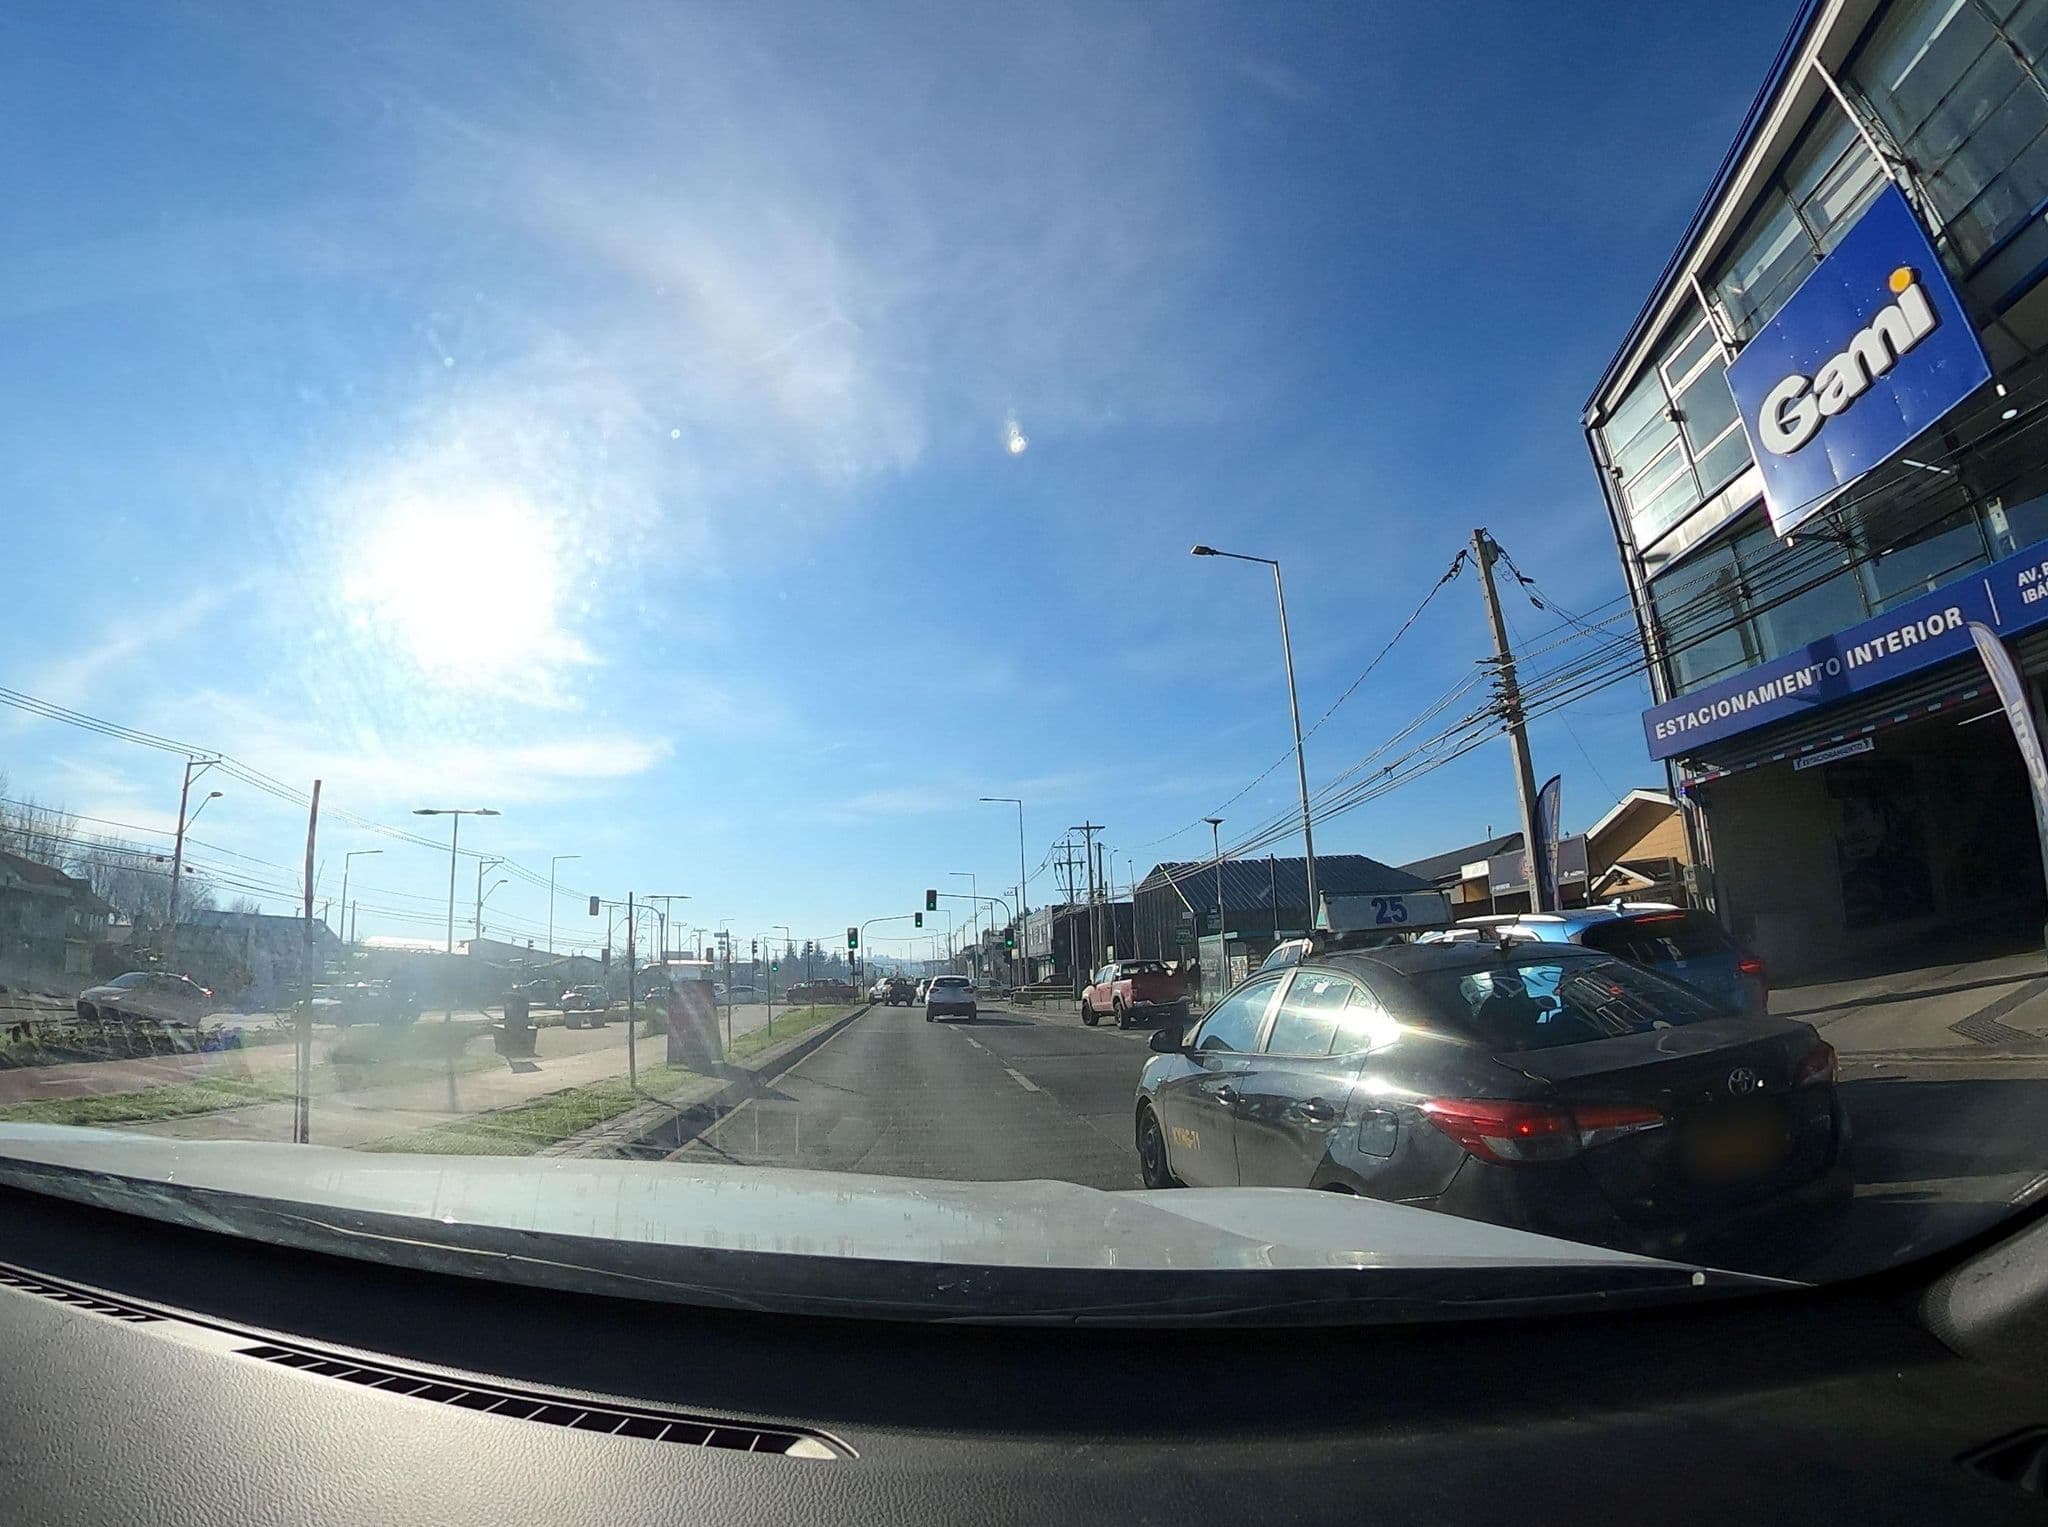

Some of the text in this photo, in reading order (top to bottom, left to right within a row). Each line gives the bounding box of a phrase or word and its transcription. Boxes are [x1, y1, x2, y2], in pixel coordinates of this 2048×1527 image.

[1759, 266, 1936, 455] Gami
[1655, 657, 1841, 739] ESTACIONAMIENTO
[1846, 606, 1963, 669] INTERIOR
[1371, 896, 1408, 924] 25
